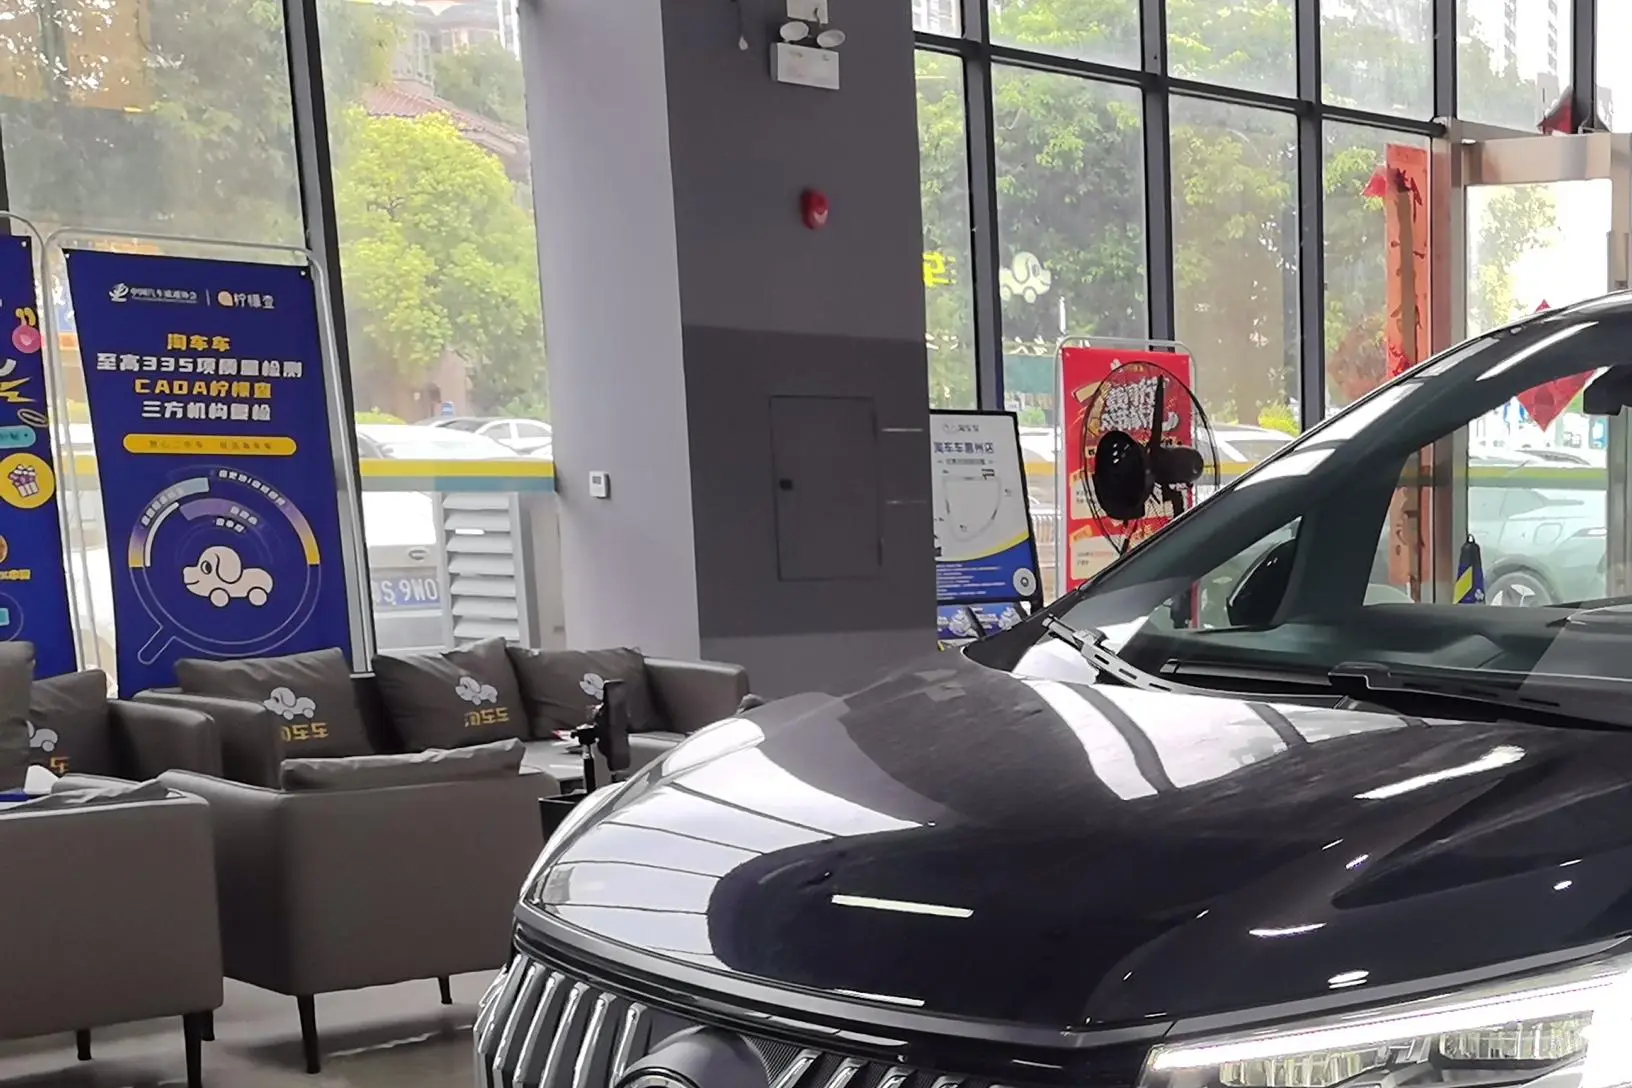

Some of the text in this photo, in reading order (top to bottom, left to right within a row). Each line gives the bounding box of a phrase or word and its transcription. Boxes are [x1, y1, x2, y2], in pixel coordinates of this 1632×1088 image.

[167, 333, 231, 352] 淘车车
[96, 353, 303, 378] 至高335项质量检测
